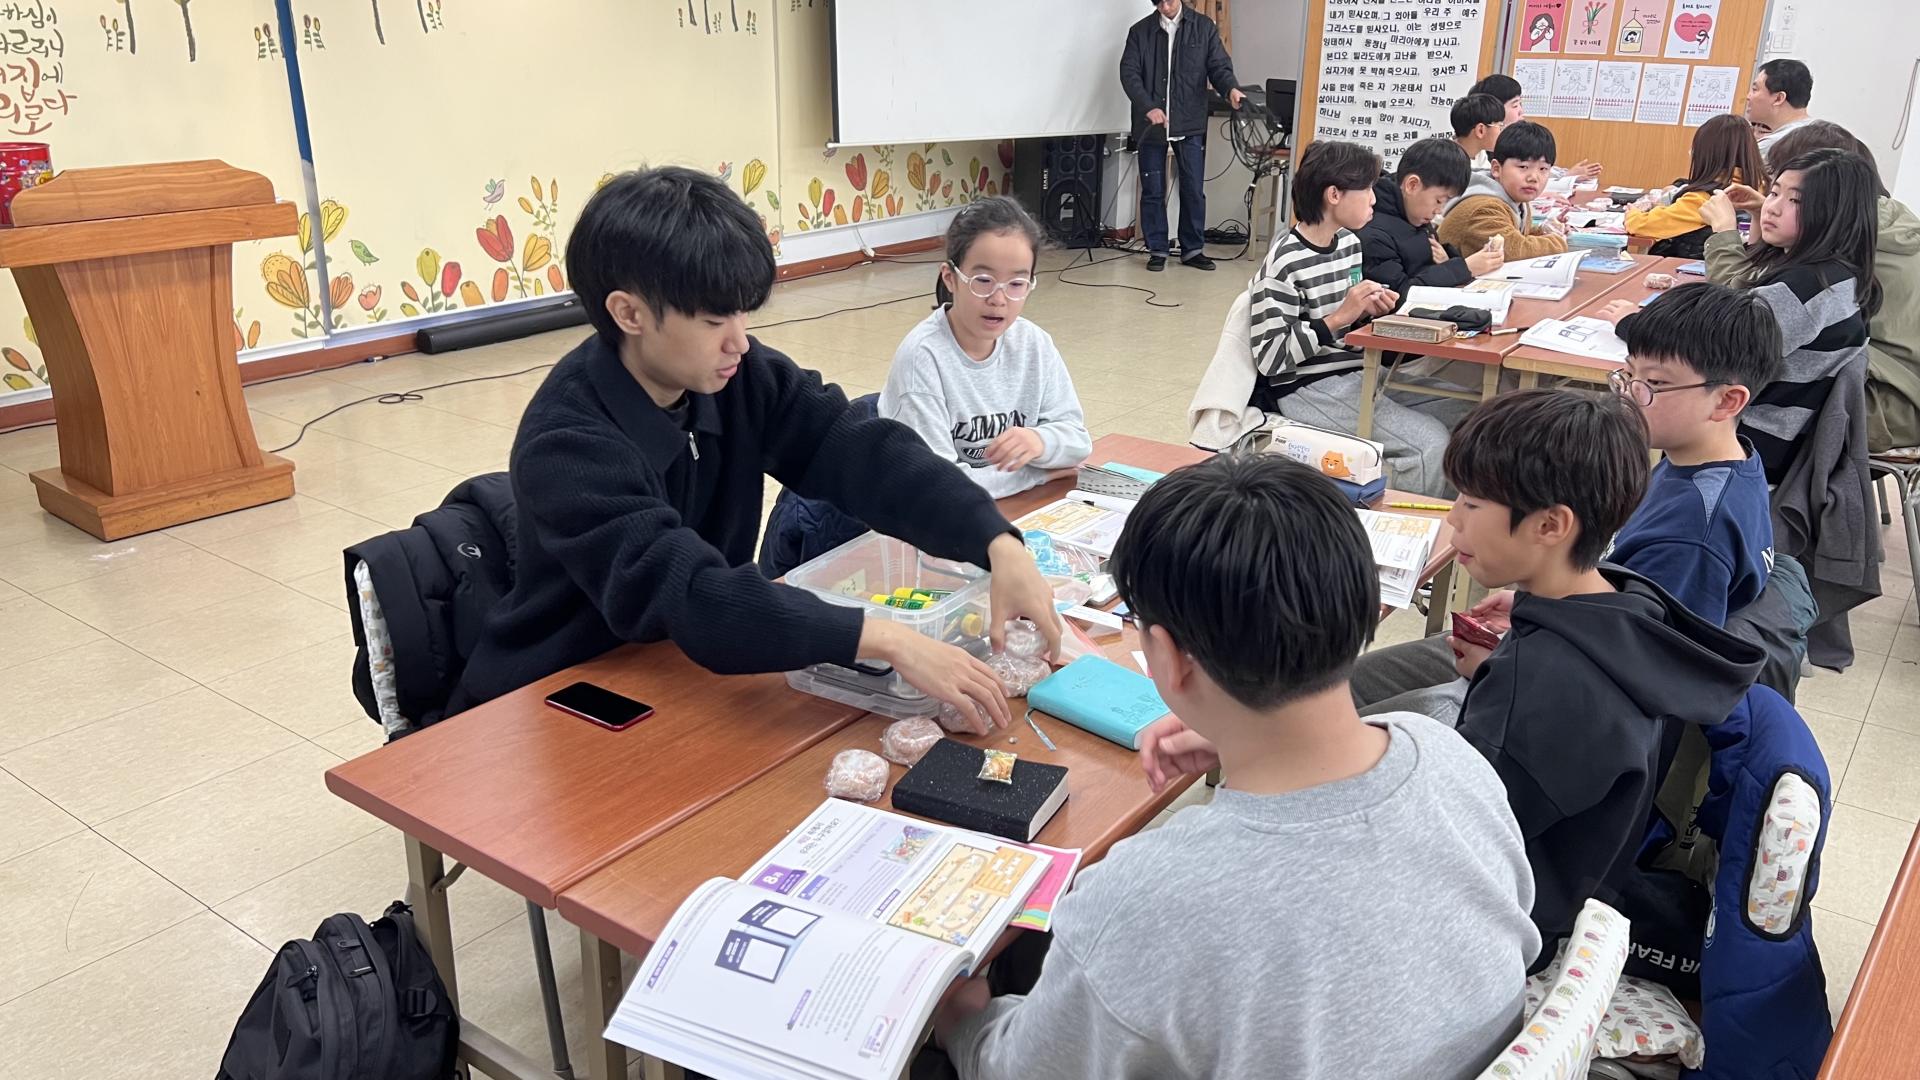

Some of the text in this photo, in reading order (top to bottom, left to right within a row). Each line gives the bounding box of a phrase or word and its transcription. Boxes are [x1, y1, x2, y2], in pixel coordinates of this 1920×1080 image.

[1329, 11, 1344, 19] 내가
[1348, 10, 1380, 20] 믿사오며,
[1383, 12, 1390, 20] 그
[1424, 8, 1439, 16] 우리
[1444, 8, 1451, 16] 주
[1462, 9, 1478, 17] 예수
[1326, 24, 1363, 33] 그리스도를
[1406, 23, 1421, 31] 이는
[1430, 21, 1461, 31] 성령으로
[1365, 39, 1387, 50] 동정녀
[1391, 35, 1430, 47] 마리아에게
[1434, 37, 1460, 46] 나시고,
[1327, 52, 1348, 60] 본디오
[1354, 52, 1391, 60] 빌라도에게
[1394, 52, 1417, 60] 고난을
[1326, 67, 1355, 75] 십자가에
[1360, 66, 1367, 75] 못
[1371, 68, 1386, 76] 박혀
[1388, 67, 1420, 76] 죽으시고,
[1433, 66, 1456, 76] 장사한
[1322, 83, 1336, 92] 사흘
[1340, 84, 1355, 92] 만에
[1360, 82, 1374, 90] 죽은
[1378, 82, 1385, 91] 자
[1430, 83, 1446, 92] 다시
[1364, 100, 1387, 108] 하늘에
[1320, 107, 1341, 119] 하나님
[1350, 116, 1372, 125] 우편에
[1380, 113, 1394, 123] 앉아
[1319, 126, 1347, 137] 저리로서
[1352, 129, 1359, 138] 산
[1363, 130, 1378, 138] 자와
[1385, 132, 1399, 141] 죽은
[1404, 131, 1418, 139] 자를
